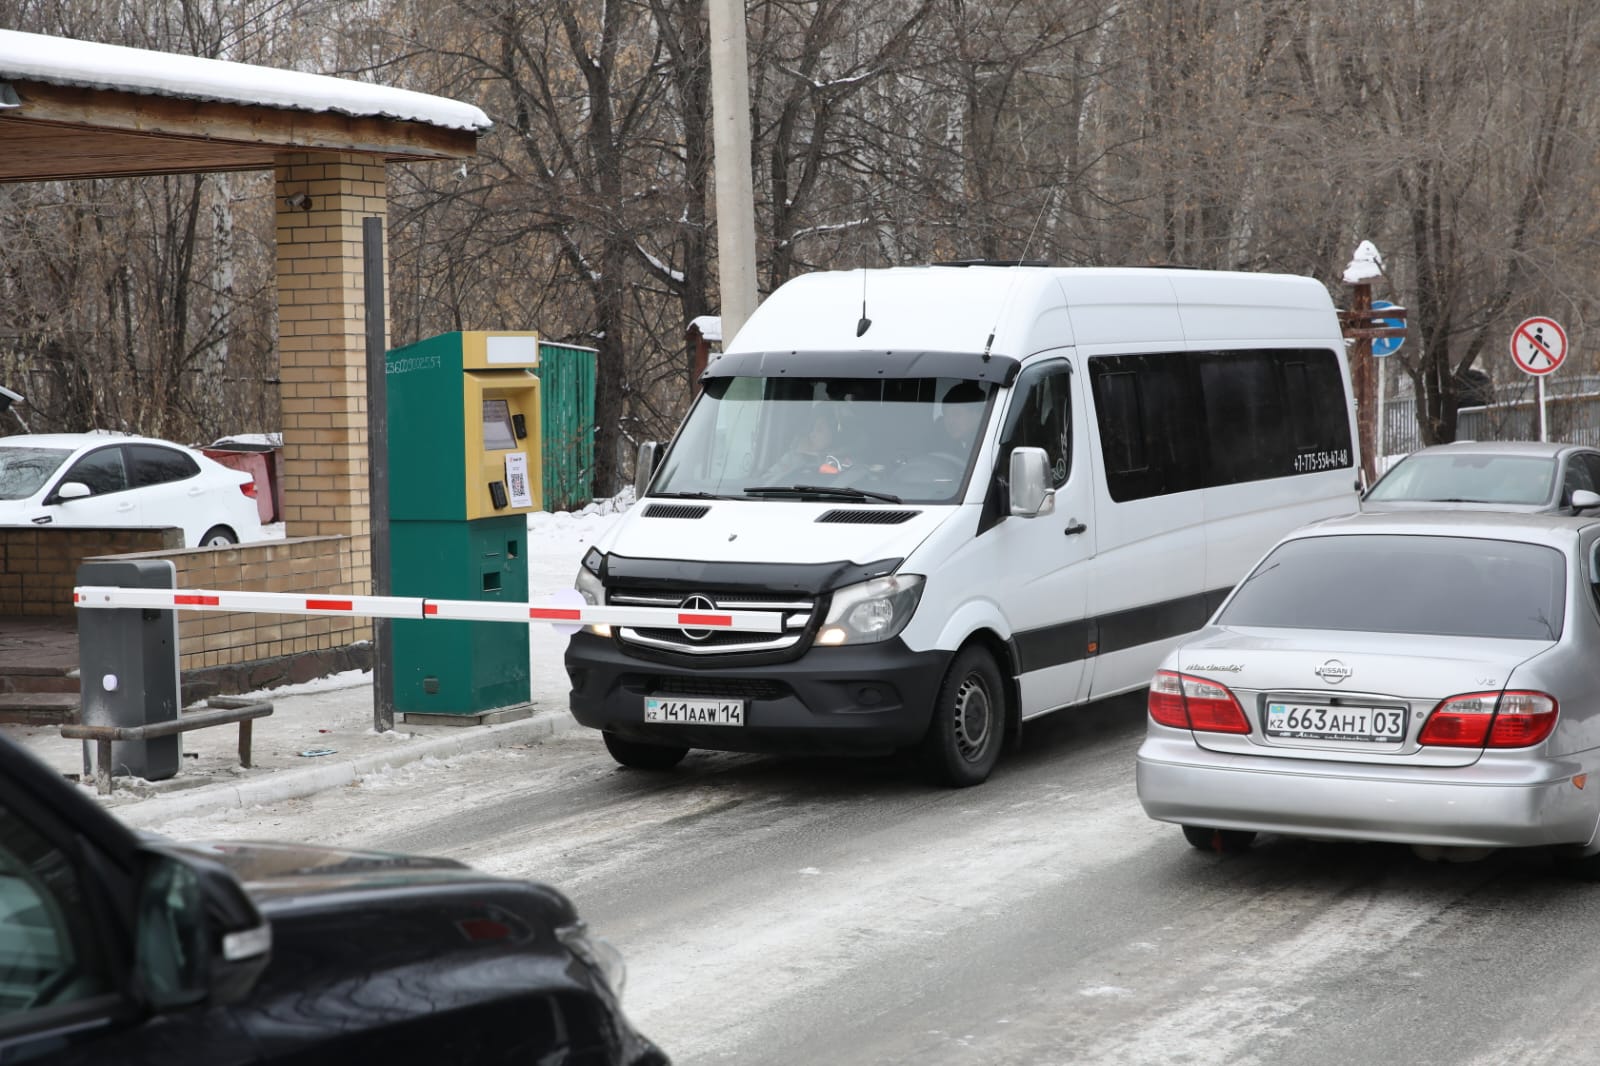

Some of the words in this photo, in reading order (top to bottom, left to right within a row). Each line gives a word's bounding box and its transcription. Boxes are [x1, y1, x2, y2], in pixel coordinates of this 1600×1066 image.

[1294, 449, 1348, 472] +7-775-554-47-48
[721, 705, 740, 723] 14
[1269, 719, 1283, 729] KZ
[1373, 712, 1401, 735] 03
